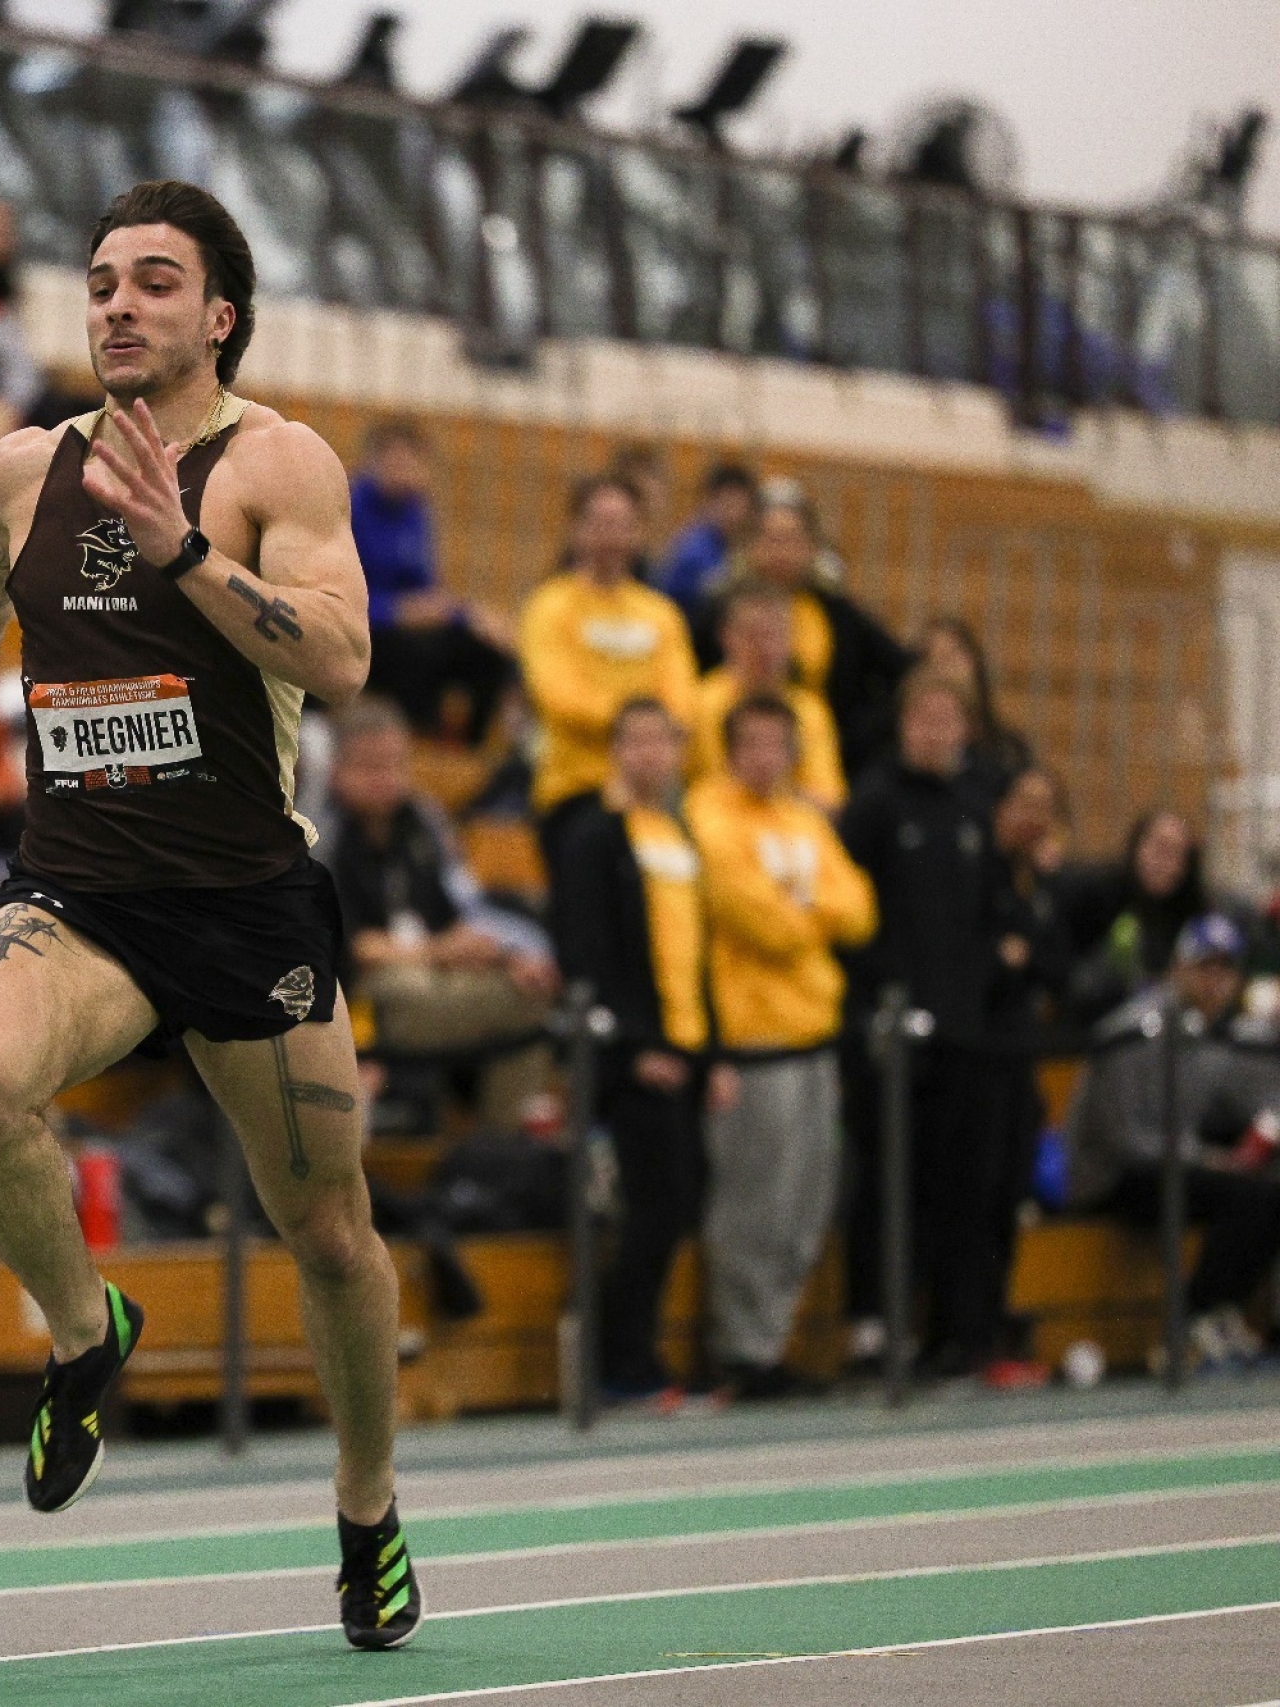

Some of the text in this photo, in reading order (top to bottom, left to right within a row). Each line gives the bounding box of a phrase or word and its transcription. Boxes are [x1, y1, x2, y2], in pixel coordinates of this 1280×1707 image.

[63, 596, 138, 611] MANITOBA
[98, 679, 161, 695] CHAMPIONSHIPS
[73, 709, 194, 757] REGNIER
